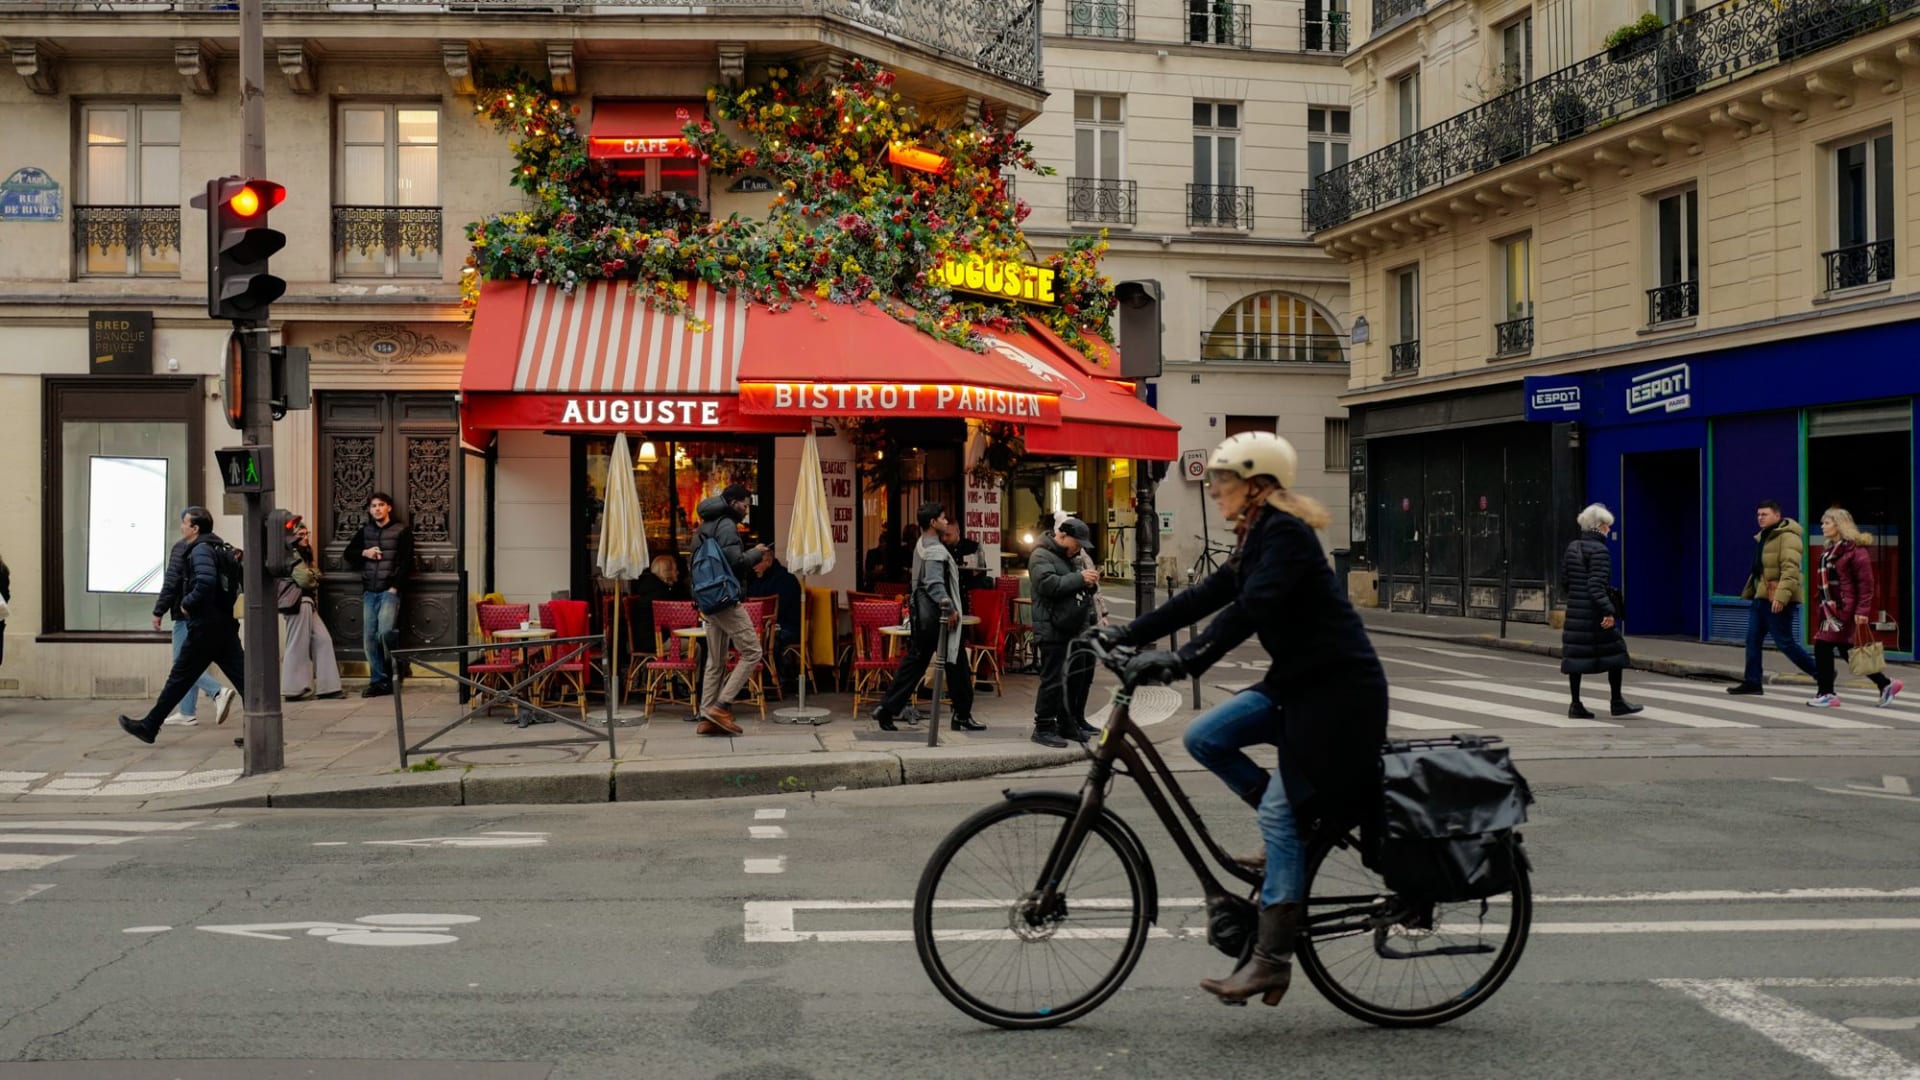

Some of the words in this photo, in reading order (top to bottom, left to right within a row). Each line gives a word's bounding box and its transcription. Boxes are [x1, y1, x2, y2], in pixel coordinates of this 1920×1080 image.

[4, 205, 19, 214] DE
[22, 205, 56, 215] RIVOLI
[95, 320, 130, 330] BRED
[95, 331, 145, 342] BANQUE
[774, 384, 922, 409] BISTROT
[936, 385, 1041, 417] PARISIEN
[561, 399, 720, 425] AUGUSTE
